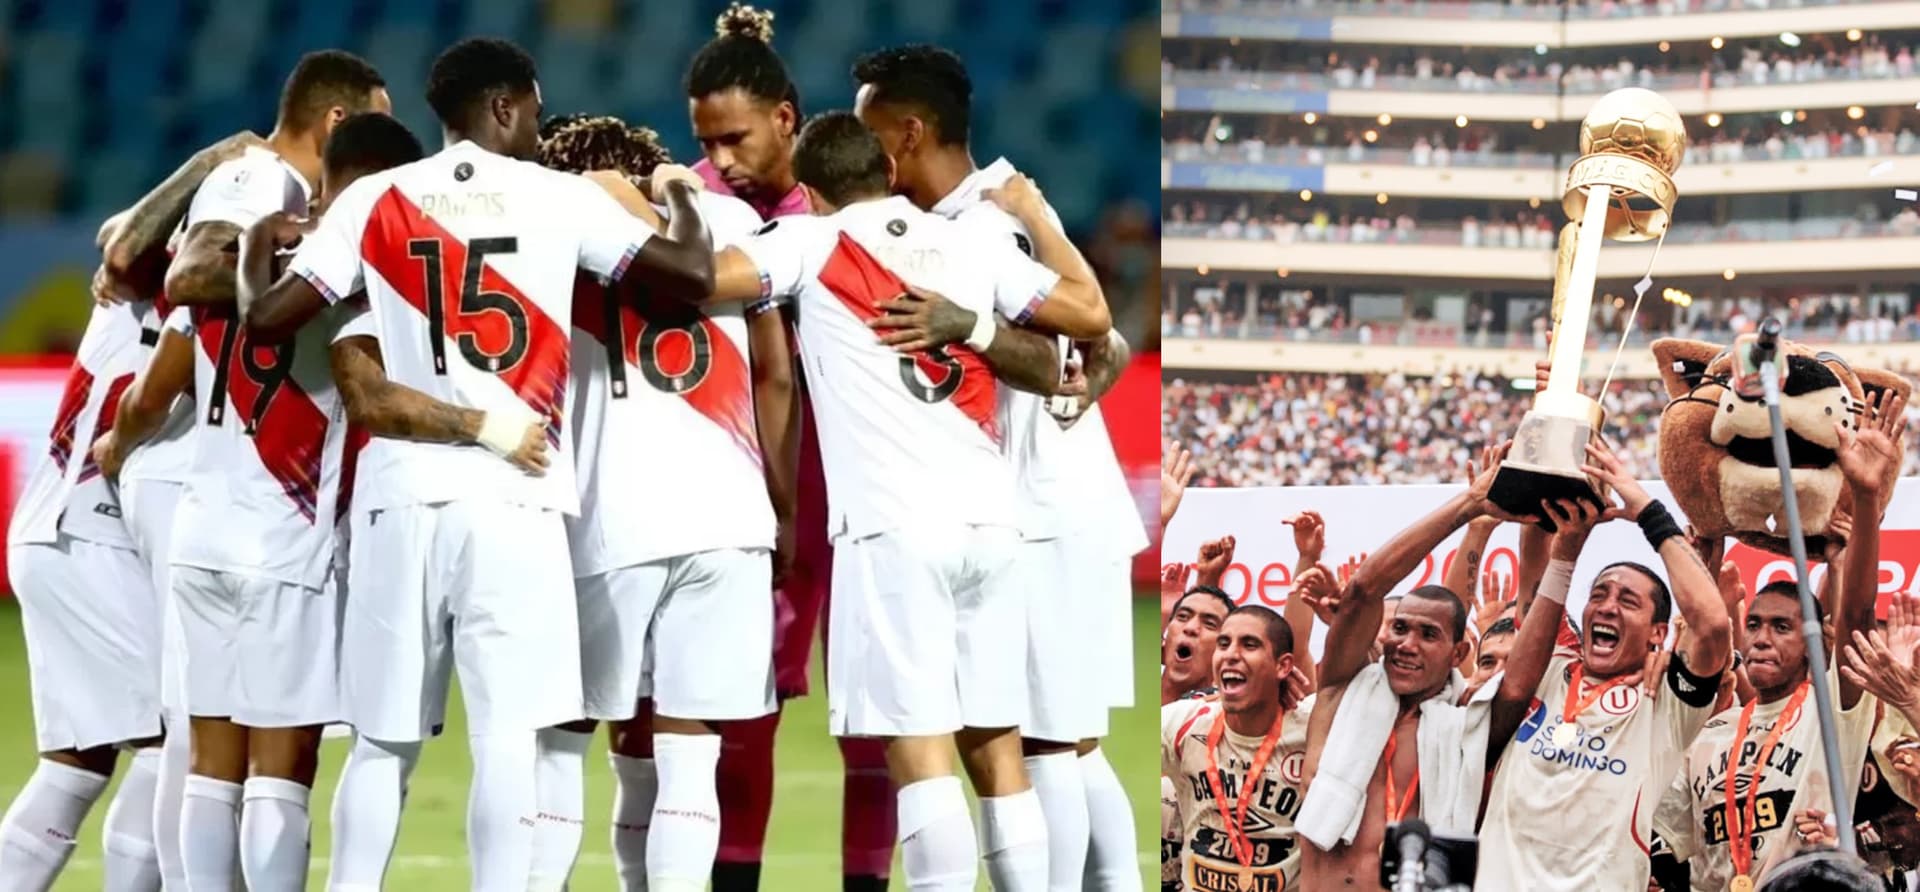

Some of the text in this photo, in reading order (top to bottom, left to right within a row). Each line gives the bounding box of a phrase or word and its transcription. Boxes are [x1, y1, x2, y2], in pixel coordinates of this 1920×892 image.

[408, 237, 529, 375] 15
[1531, 739, 1626, 775] DOMINGO
[1693, 741, 1802, 801] CAMPON
[1208, 832, 1270, 865] 209
[1197, 865, 1272, 892] CRISAL
